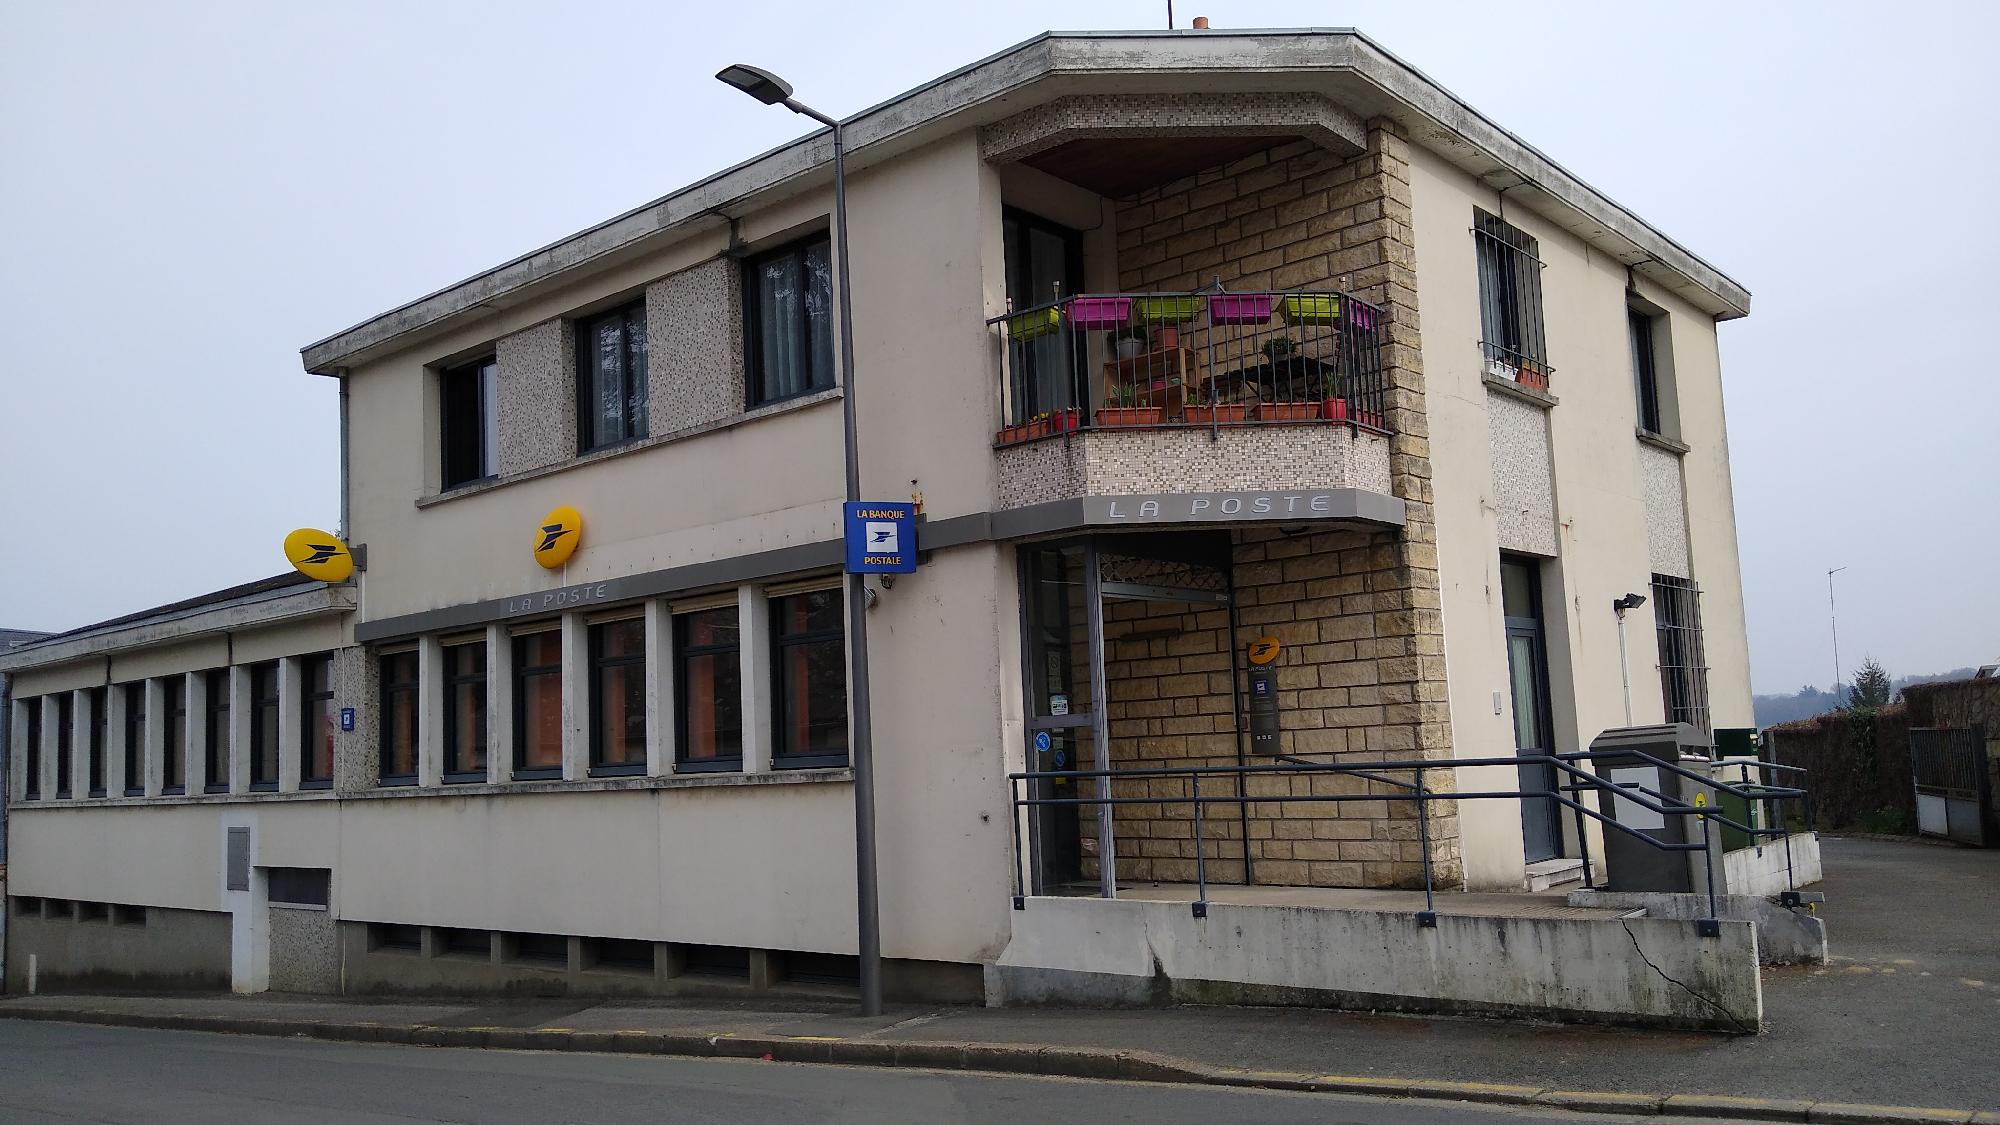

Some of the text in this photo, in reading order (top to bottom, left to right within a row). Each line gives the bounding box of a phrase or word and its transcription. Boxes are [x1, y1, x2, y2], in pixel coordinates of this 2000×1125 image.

[857, 510, 905, 519] LA BANQUE
[1109, 495, 1331, 518] LA POSTE
[864, 556, 902, 565] POSTALE
[509, 584, 607, 613] LA POSTE
